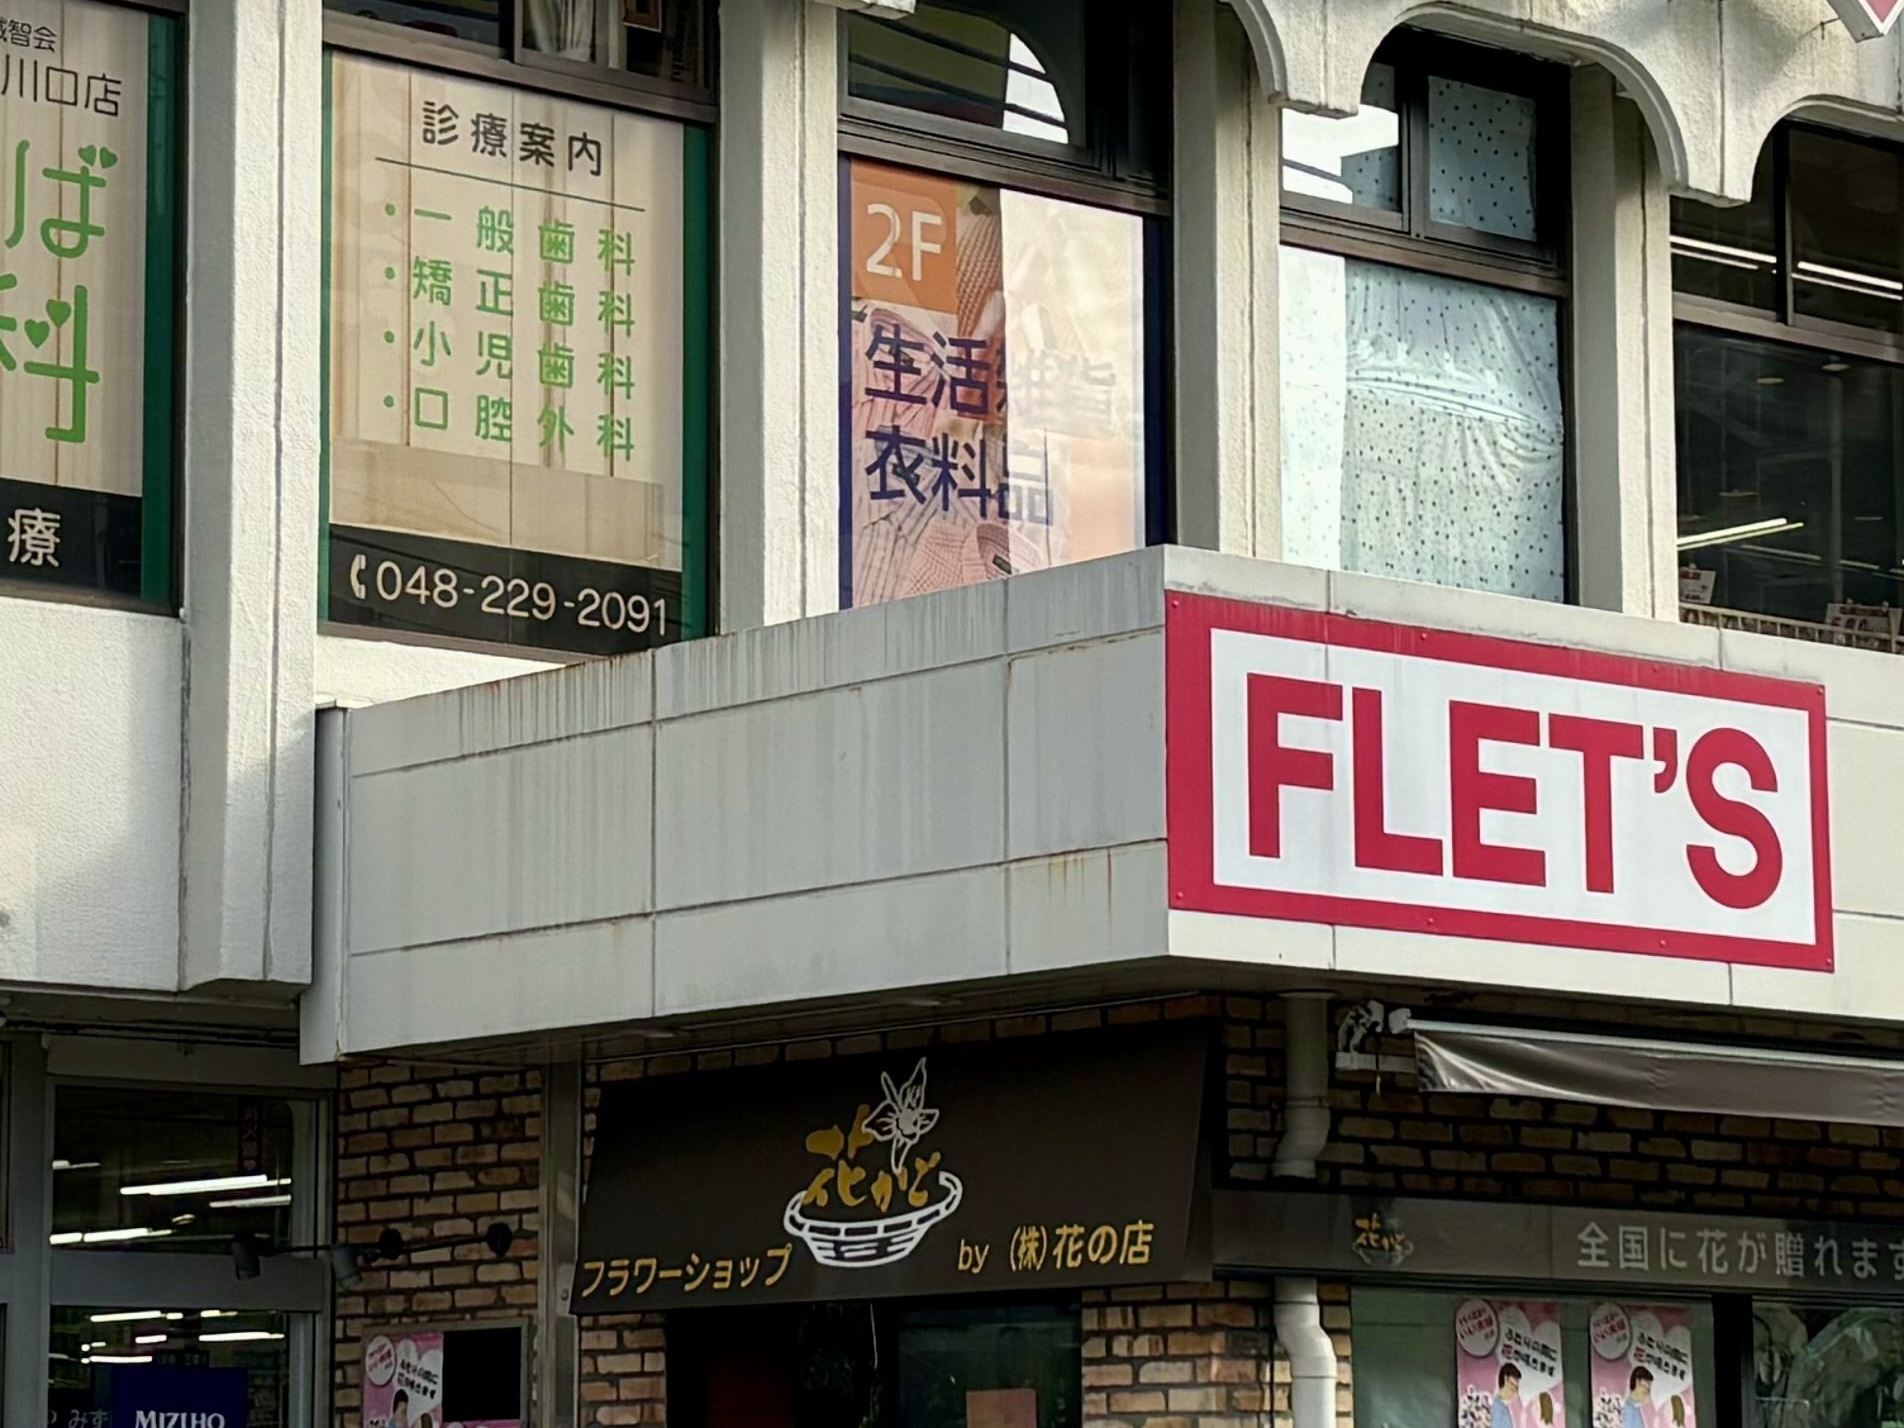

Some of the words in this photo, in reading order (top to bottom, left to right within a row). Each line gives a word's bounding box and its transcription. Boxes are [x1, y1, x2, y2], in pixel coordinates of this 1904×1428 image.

[421, 100, 604, 177] 診療案内
[413, 203, 635, 276] 一般歯科
[863, 204, 943, 280] 2F
[412, 256, 635, 338] 矯正歯科
[412, 319, 635, 400] 小児歯科
[412, 387, 635, 463] 口腔外科
[865, 421, 1053, 524] 衣料品
[376, 559, 668, 636] 048-229-2091
[1246, 671, 1783, 909] FLET'S
[580, 1242, 792, 1298] フラワーショップ
[958, 1240, 990, 1274] by
[1009, 1219, 1154, 1272] (株)花の店
